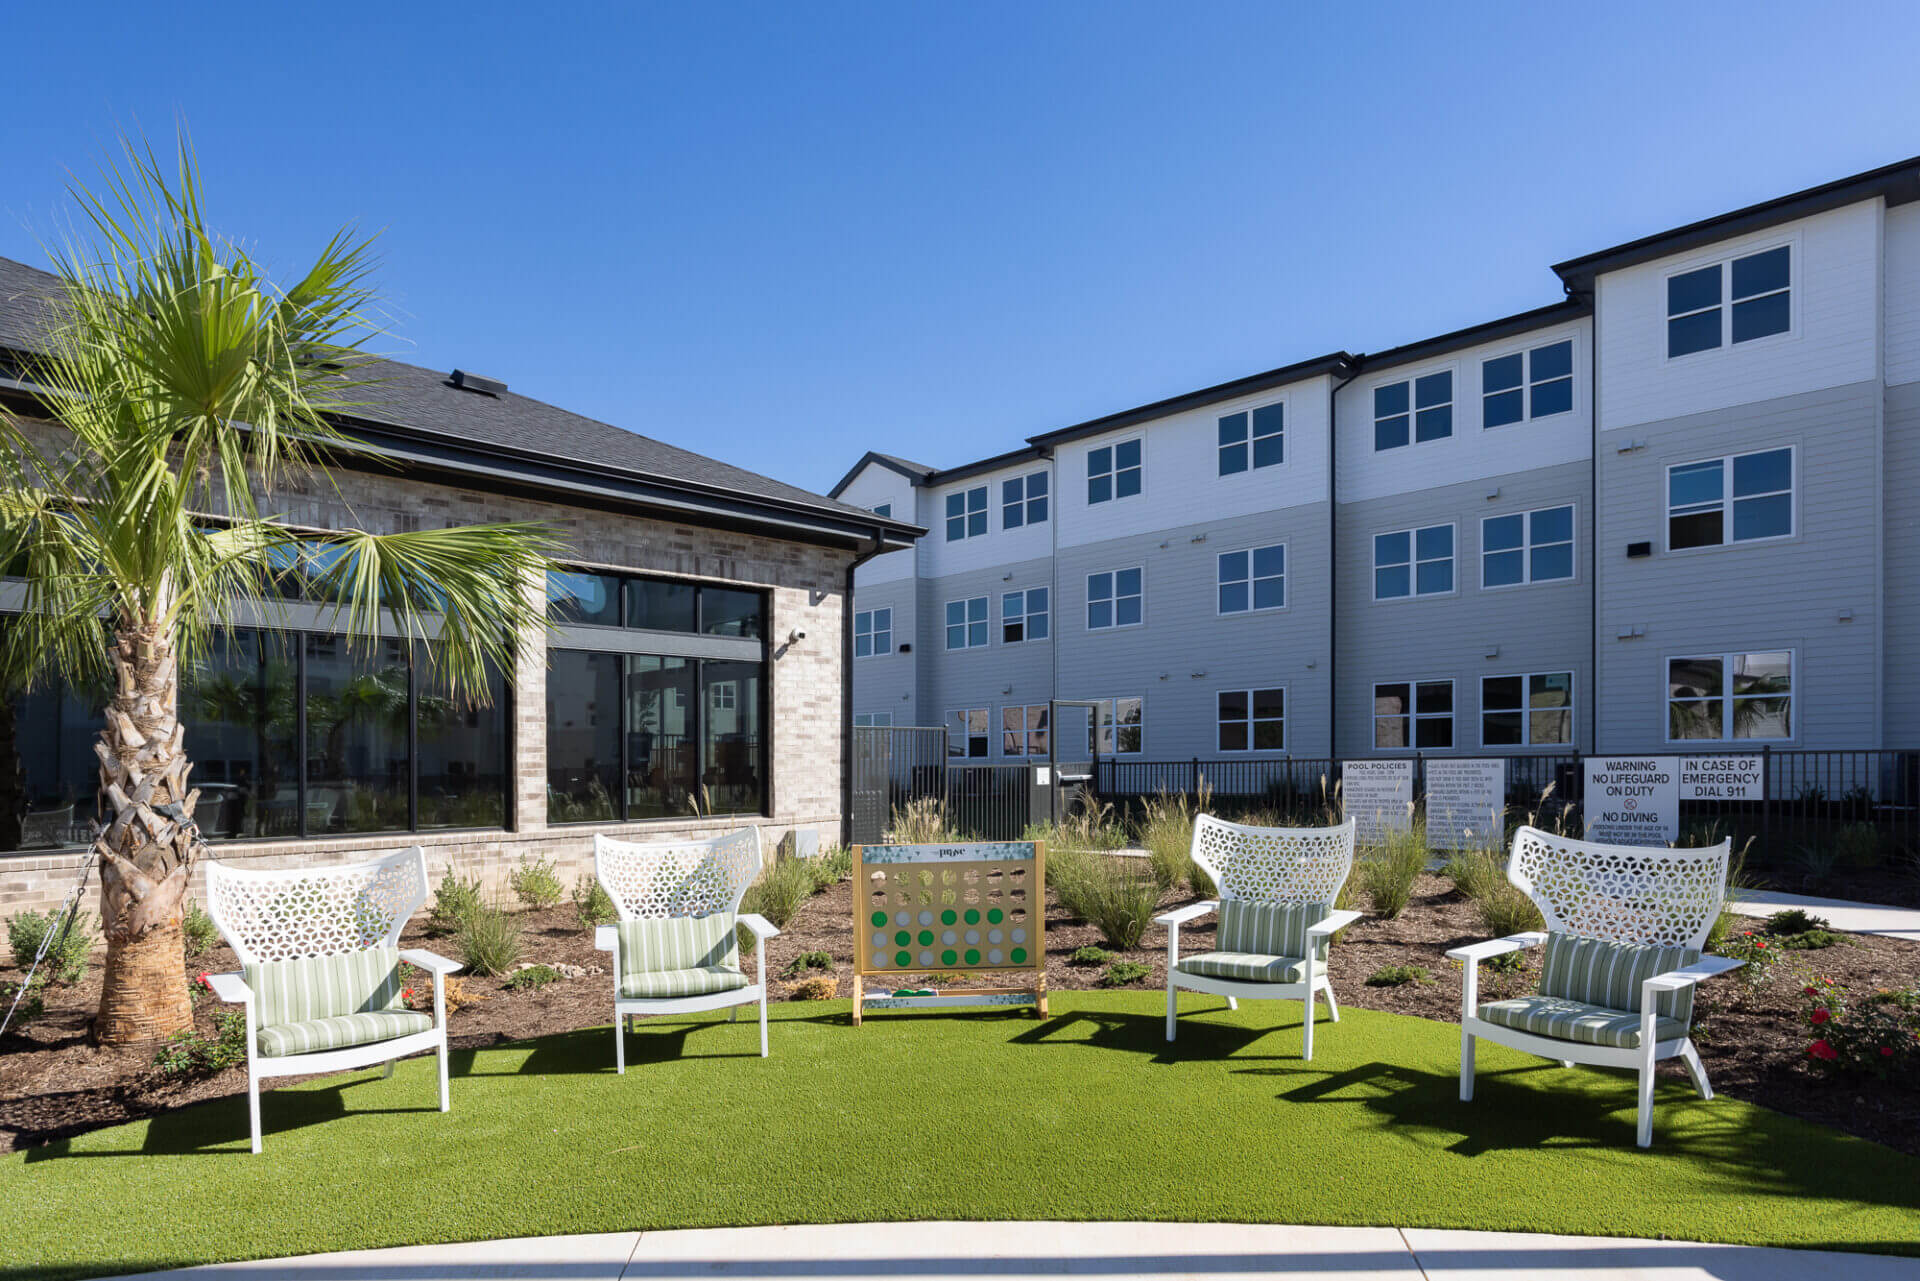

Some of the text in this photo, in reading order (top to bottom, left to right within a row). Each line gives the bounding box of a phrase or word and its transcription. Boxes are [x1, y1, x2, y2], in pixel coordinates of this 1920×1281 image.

[1606, 761, 1656, 771] WARNING
[1686, 761, 1756, 771] IN CASE OF
[1593, 774, 1669, 784] NO LIFEGUARD
[1682, 774, 1760, 784] EMERGENCY
[1606, 786, 1654, 796] ON DUTY
[1695, 786, 1746, 796] DIAL 911
[1603, 812, 1658, 822] NO DIVING
